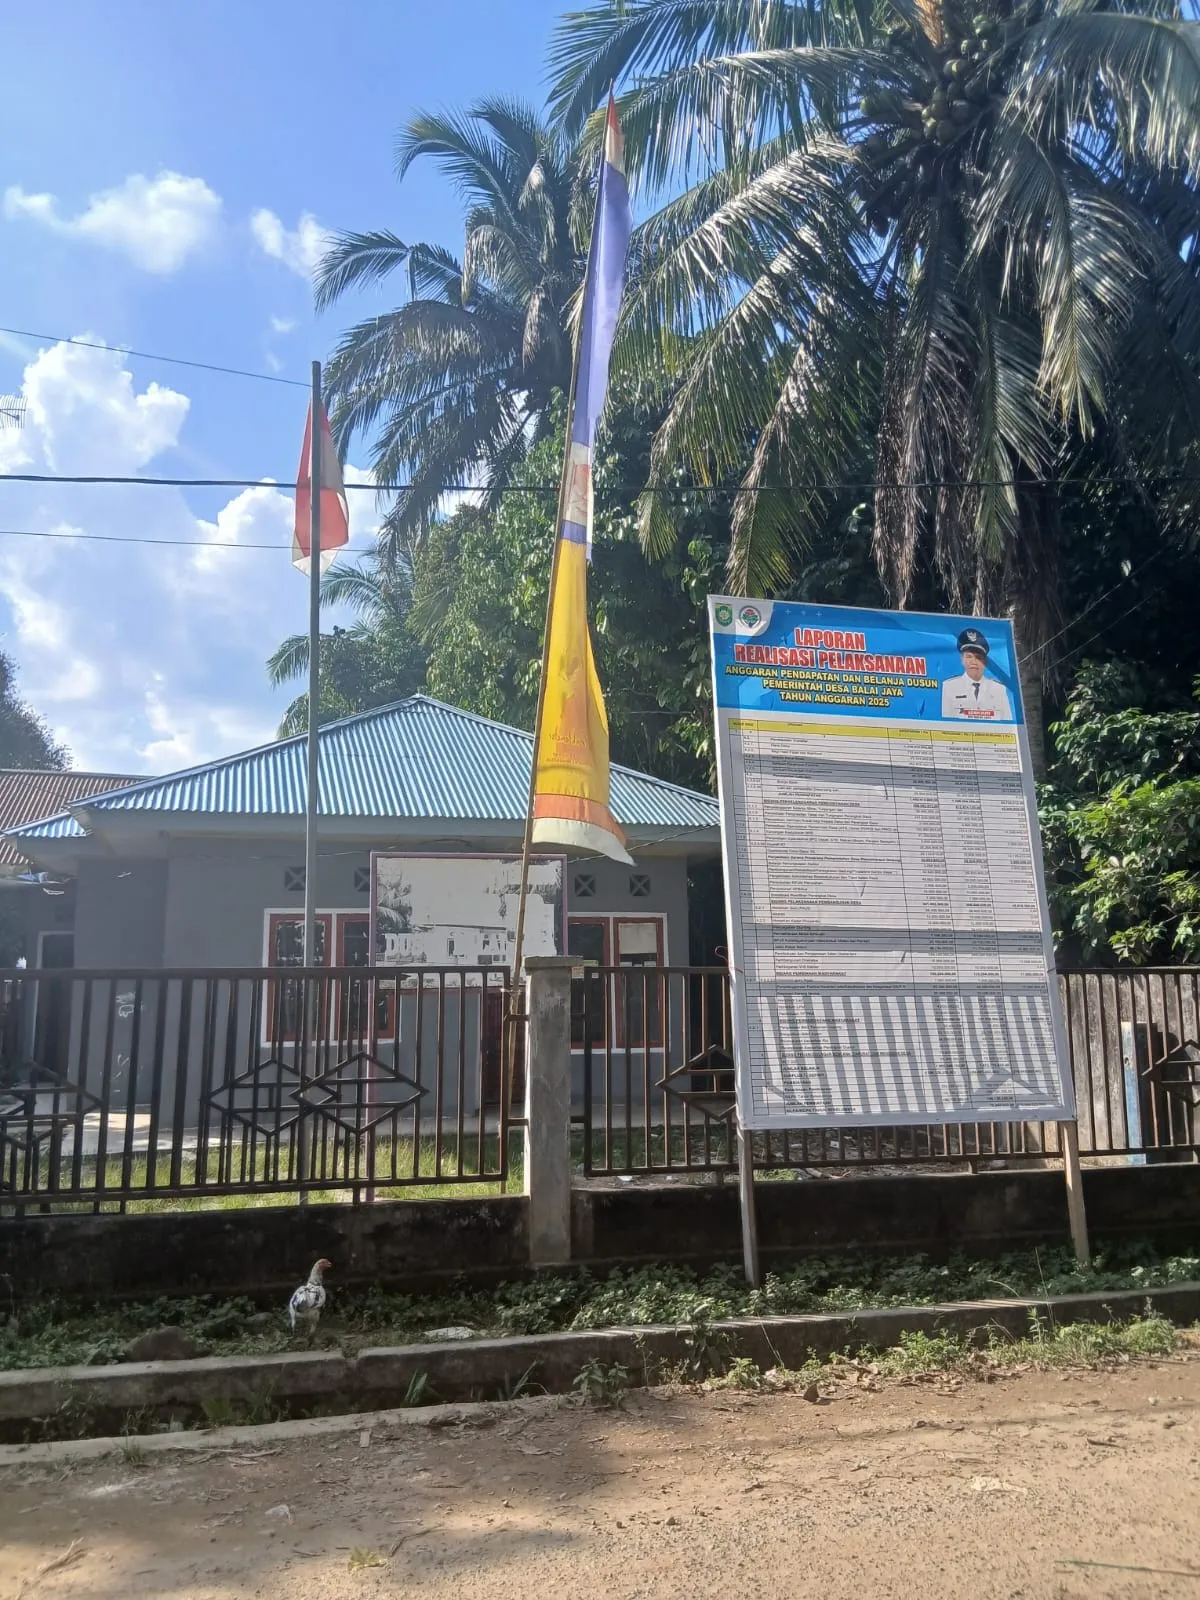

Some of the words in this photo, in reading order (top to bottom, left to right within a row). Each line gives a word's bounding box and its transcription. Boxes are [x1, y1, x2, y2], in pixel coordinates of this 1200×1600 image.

[794, 628, 866, 651] LAPORAN
[734, 644, 816, 668] REALISASI
[818, 650, 927, 676] PELAKSANAAN
[725, 666, 778, 677] ANGGARAN
[781, 670, 840, 681] PENDAPATAN
[843, 674, 861, 683] DAN
[864, 676, 904, 686] BELANJA
[907, 679, 938, 688] DUSUN
[763, 680, 823, 691] PEMERINTAH
[825, 684, 850, 693] DESA
[852, 686, 878, 696] BALAI
[881, 688, 903, 697] JAYA
[780, 692, 811, 701] TAHUN
[815, 694, 866, 705] ANGGARAN
[868, 698, 890, 707] 2025
